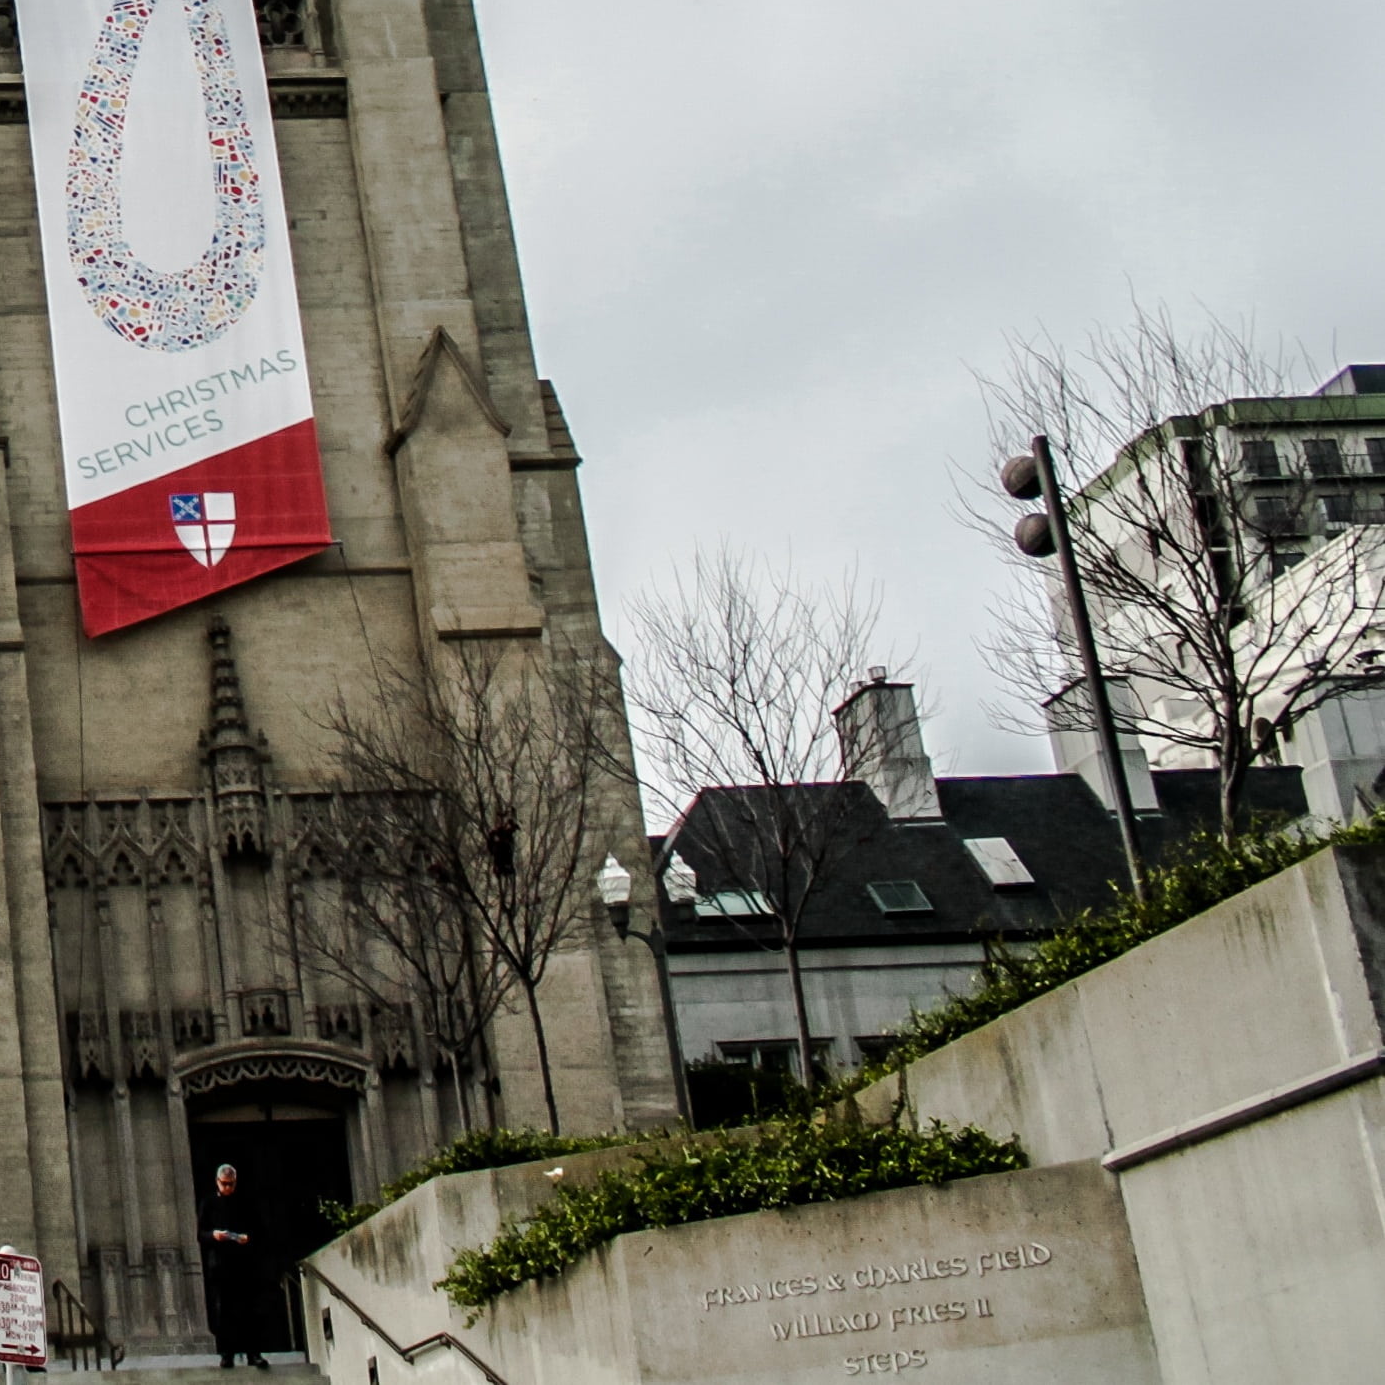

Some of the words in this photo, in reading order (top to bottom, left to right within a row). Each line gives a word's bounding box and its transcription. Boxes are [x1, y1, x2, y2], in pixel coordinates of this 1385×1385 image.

[125, 349, 297, 428] CHRISTMAS
[77, 409, 224, 480] SERVICES
[700, 1273, 818, 1311] FRANCES
[823, 1273, 845, 1292] &
[976, 1242, 1053, 1277] FIELD
[890, 1301, 966, 1332] FRIES
[844, 1348, 928, 1377] STEPS
